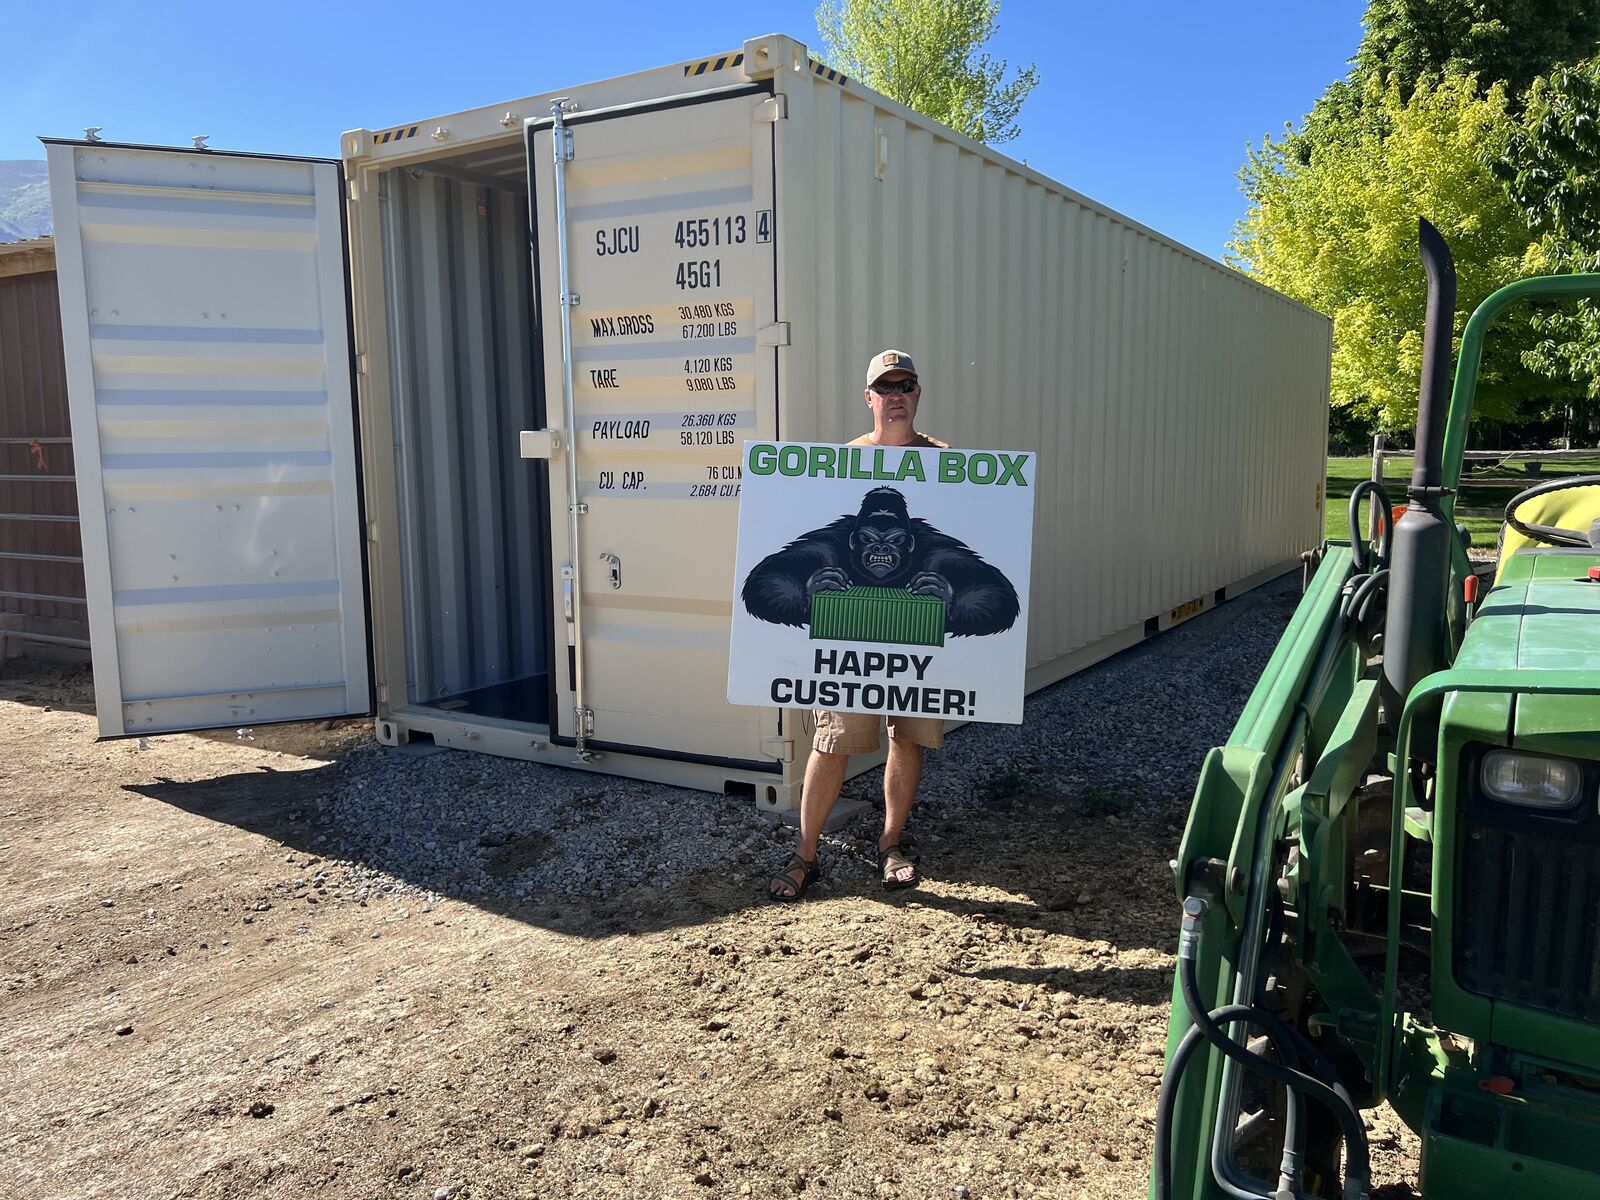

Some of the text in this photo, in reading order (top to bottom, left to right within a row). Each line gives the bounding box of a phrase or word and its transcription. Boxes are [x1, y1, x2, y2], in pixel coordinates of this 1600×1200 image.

[596, 212, 769, 256] SJCU 455113 4
[675, 259, 721, 290] 45G1
[714, 302, 735, 317] KGS
[590, 314, 655, 338] MAX.GROSS
[718, 321, 737, 337] LBS
[714, 357, 733, 372] KGS
[590, 369, 620, 389] TARE
[716, 376, 736, 390] LBS
[716, 413, 737, 427] KGS
[592, 420, 650, 440] PAYLOAD
[716, 430, 735, 445] LBS
[706, 465, 719, 480] 76
[749, 444, 1029, 487] GORILLA BOX
[599, 471, 647, 490] CU. CAP.
[813, 648, 934, 681] HAPPY
[770, 677, 977, 716] CUSTOMER!
